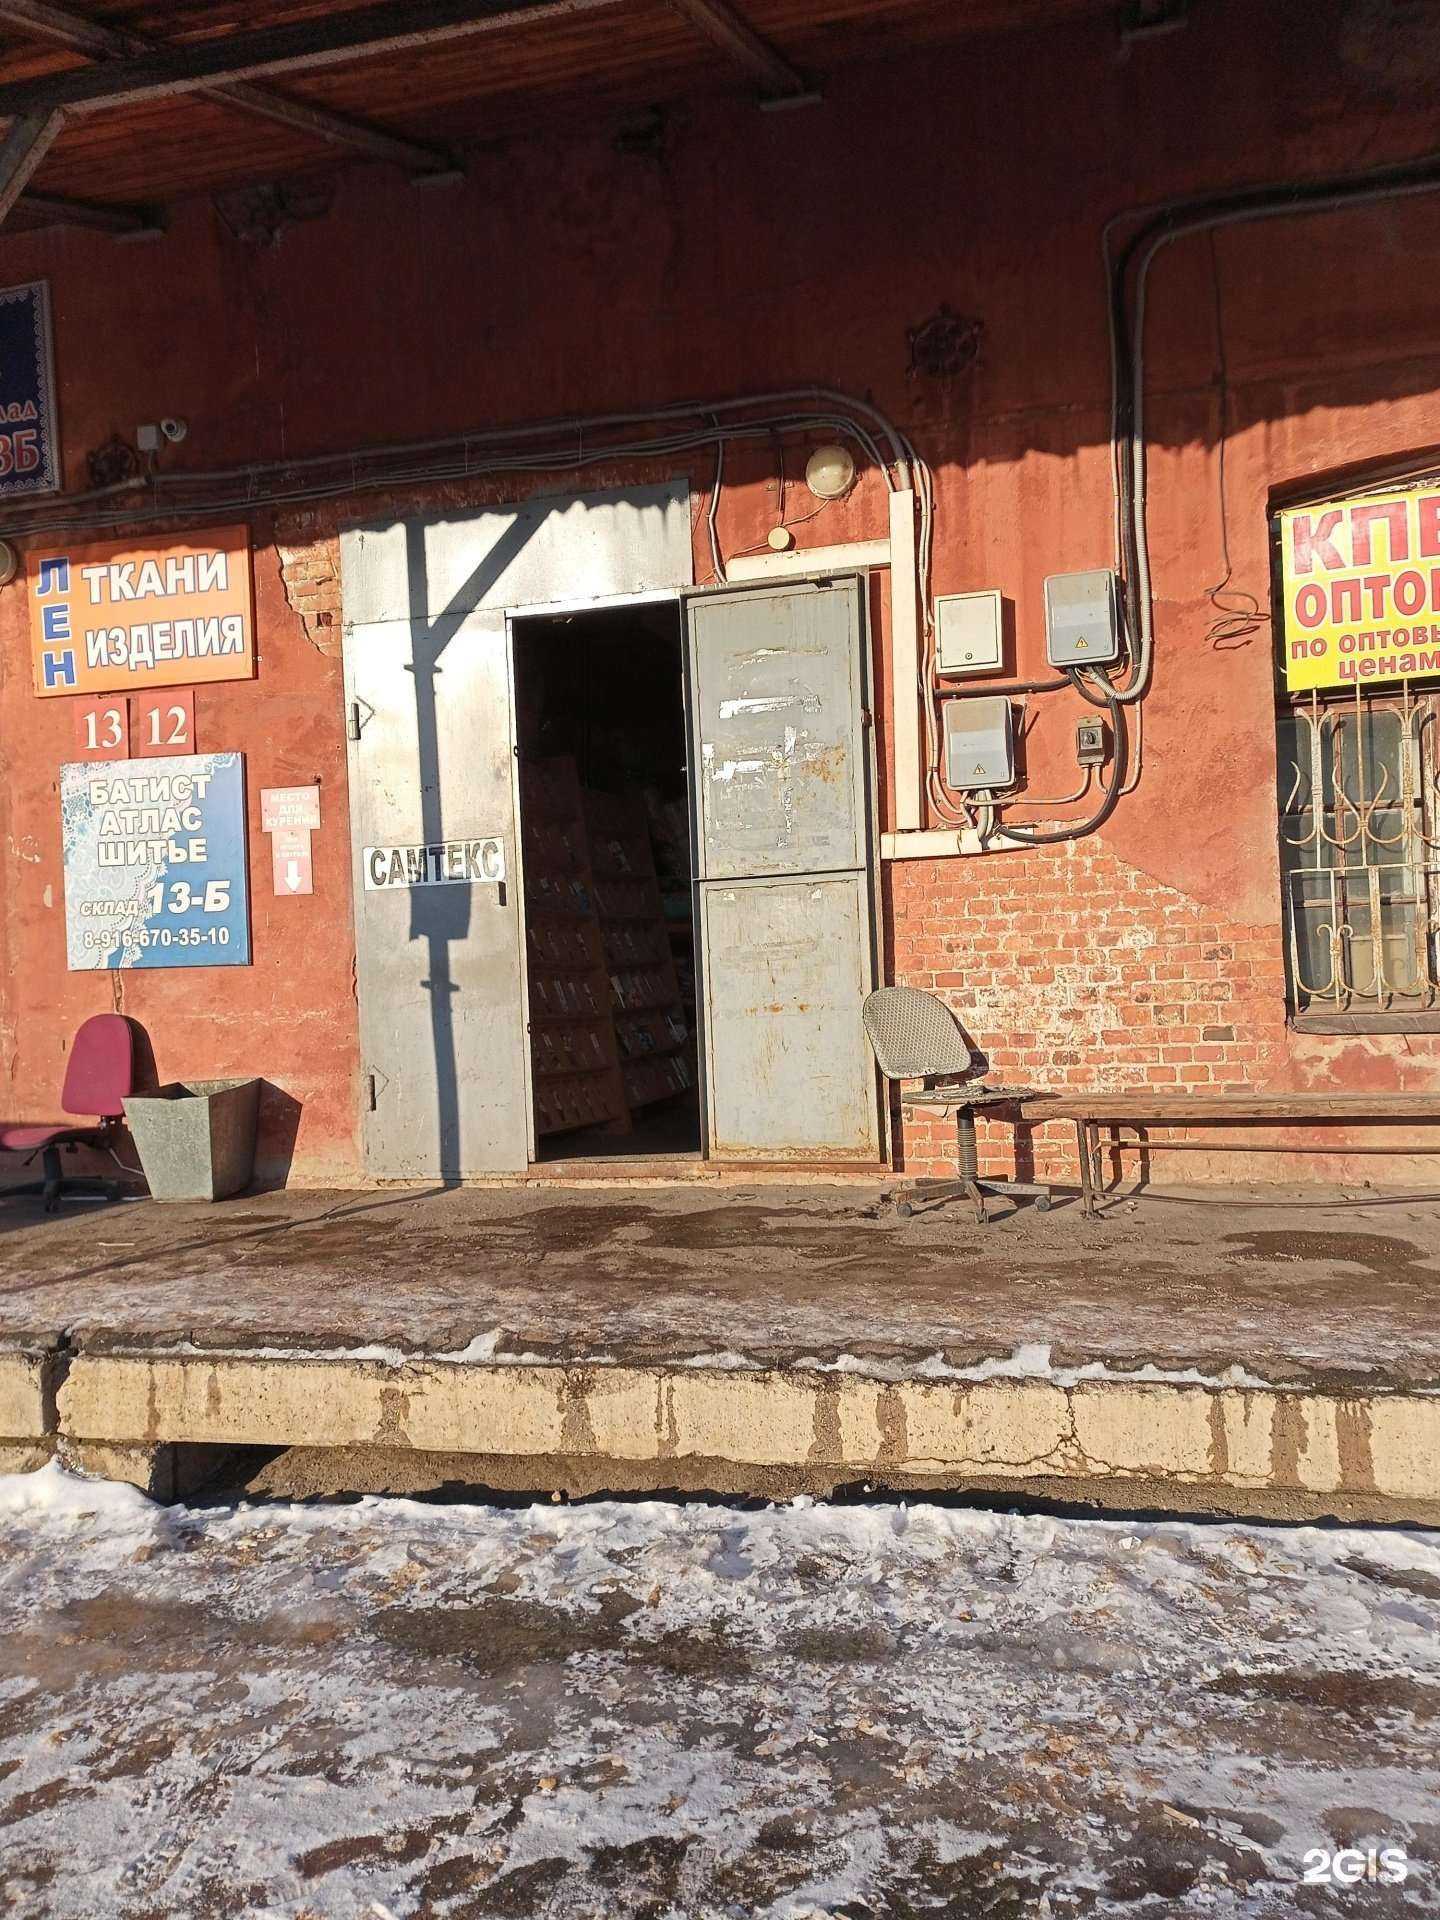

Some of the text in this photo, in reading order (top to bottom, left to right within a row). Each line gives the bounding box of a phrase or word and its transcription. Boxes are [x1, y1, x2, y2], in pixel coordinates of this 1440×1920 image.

[81, 552, 229, 606] ТКАНИ
[36, 556, 76, 690] ЛЕН
[85, 615, 244, 671] ИЗДЕЛИЯ
[1291, 637, 1327, 659] по
[82, 709, 122, 749] 13
[146, 706, 188, 745] 12
[89, 774, 211, 805] БАТИСТ
[100, 806, 203, 836] АТЛАС
[97, 838, 208, 867] ШИТЬЕ
[80, 880, 231, 918] СКЛАД 13-Б
[84, 926, 229, 949] 8-916-670-35-10
